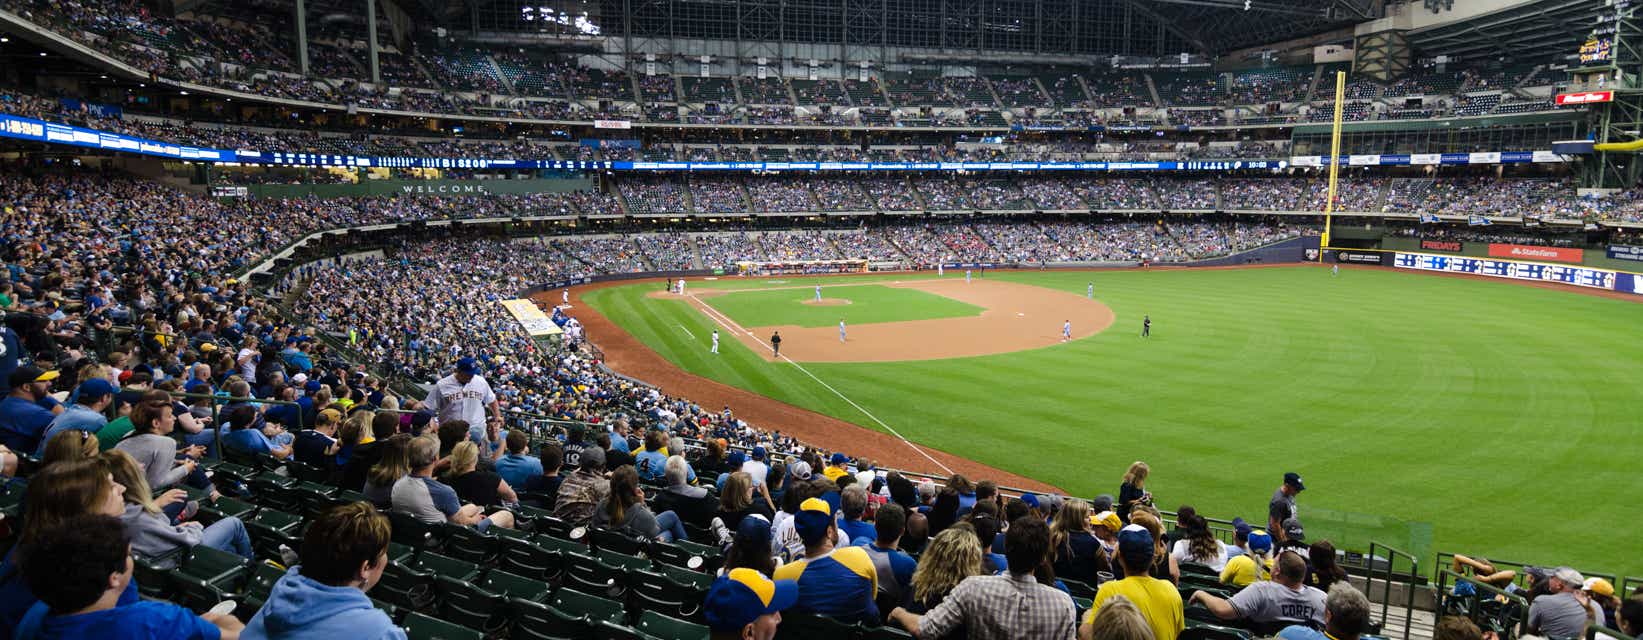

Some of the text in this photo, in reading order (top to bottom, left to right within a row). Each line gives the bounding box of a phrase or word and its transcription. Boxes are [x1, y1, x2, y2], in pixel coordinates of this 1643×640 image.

[403, 185, 485, 193] WELCOME
[1422, 240, 1461, 251] FRIDAYS
[640, 458, 650, 472] 4
[1281, 604, 1317, 618] COREY
